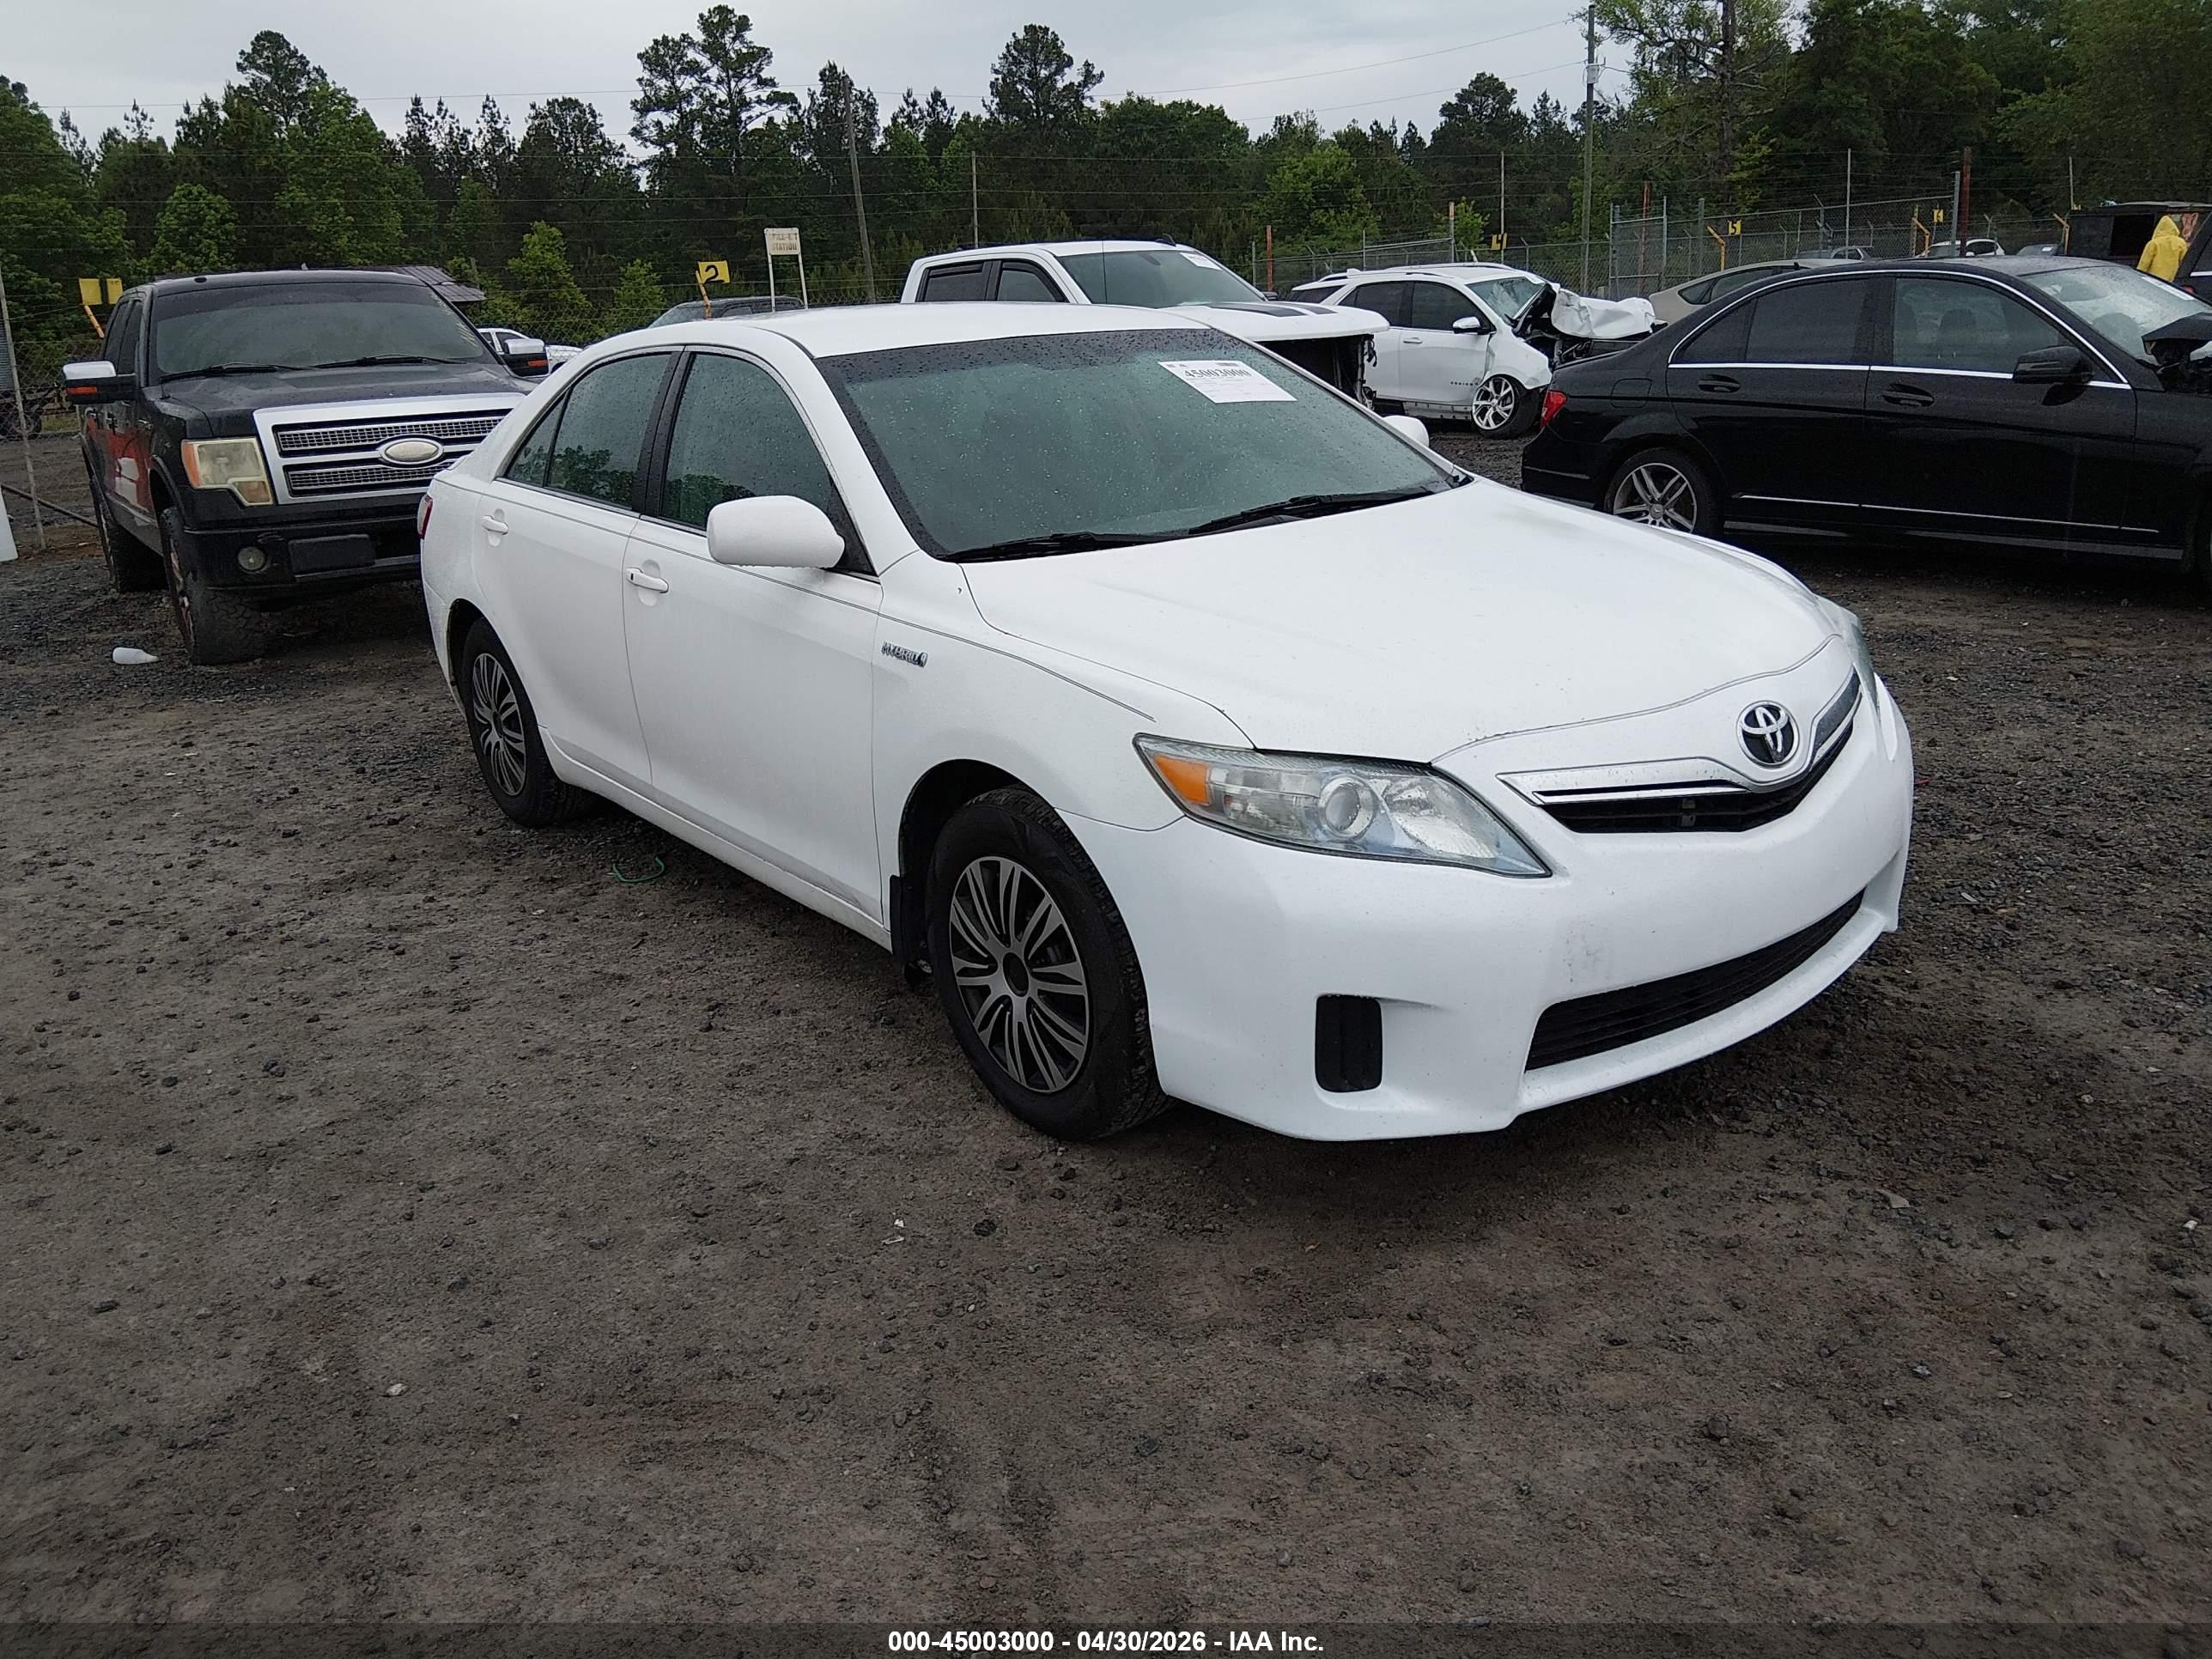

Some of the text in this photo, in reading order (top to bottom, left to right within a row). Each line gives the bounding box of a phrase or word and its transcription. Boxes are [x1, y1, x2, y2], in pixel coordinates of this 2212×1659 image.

[1731, 220, 1739, 234] 5
[1496, 234, 1504, 250] 4
[704, 264, 725, 284] 2
[1184, 368, 1253, 379] 45003000
